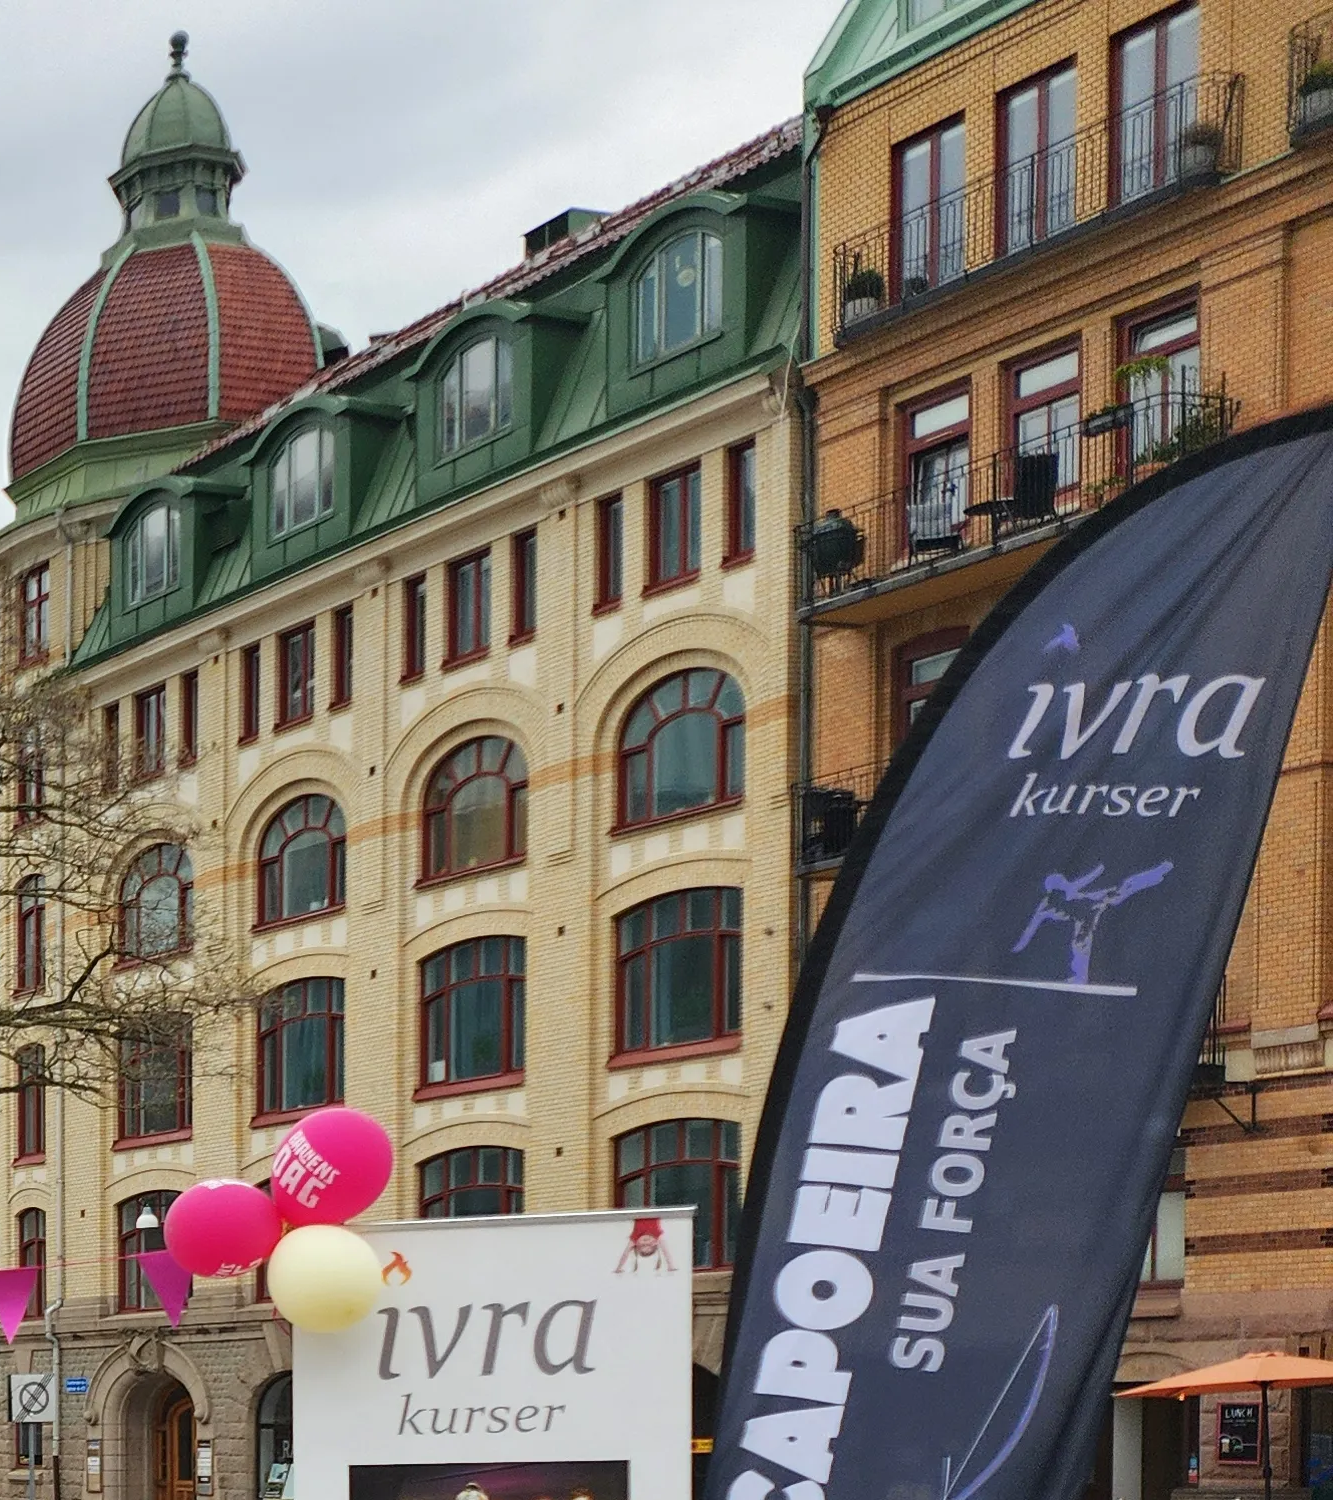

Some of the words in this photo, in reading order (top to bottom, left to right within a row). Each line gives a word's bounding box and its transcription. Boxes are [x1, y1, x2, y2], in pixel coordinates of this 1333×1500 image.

[1008, 672, 1266, 760] ivra
[1010, 772, 1201, 818] kurser
[923, 1029, 1018, 1233] FORÇA
[273, 1143, 326, 1209] DAG
[376, 1299, 597, 1380] ivra
[893, 1252, 966, 1373] SUA
[397, 1395, 566, 1435] kurser
